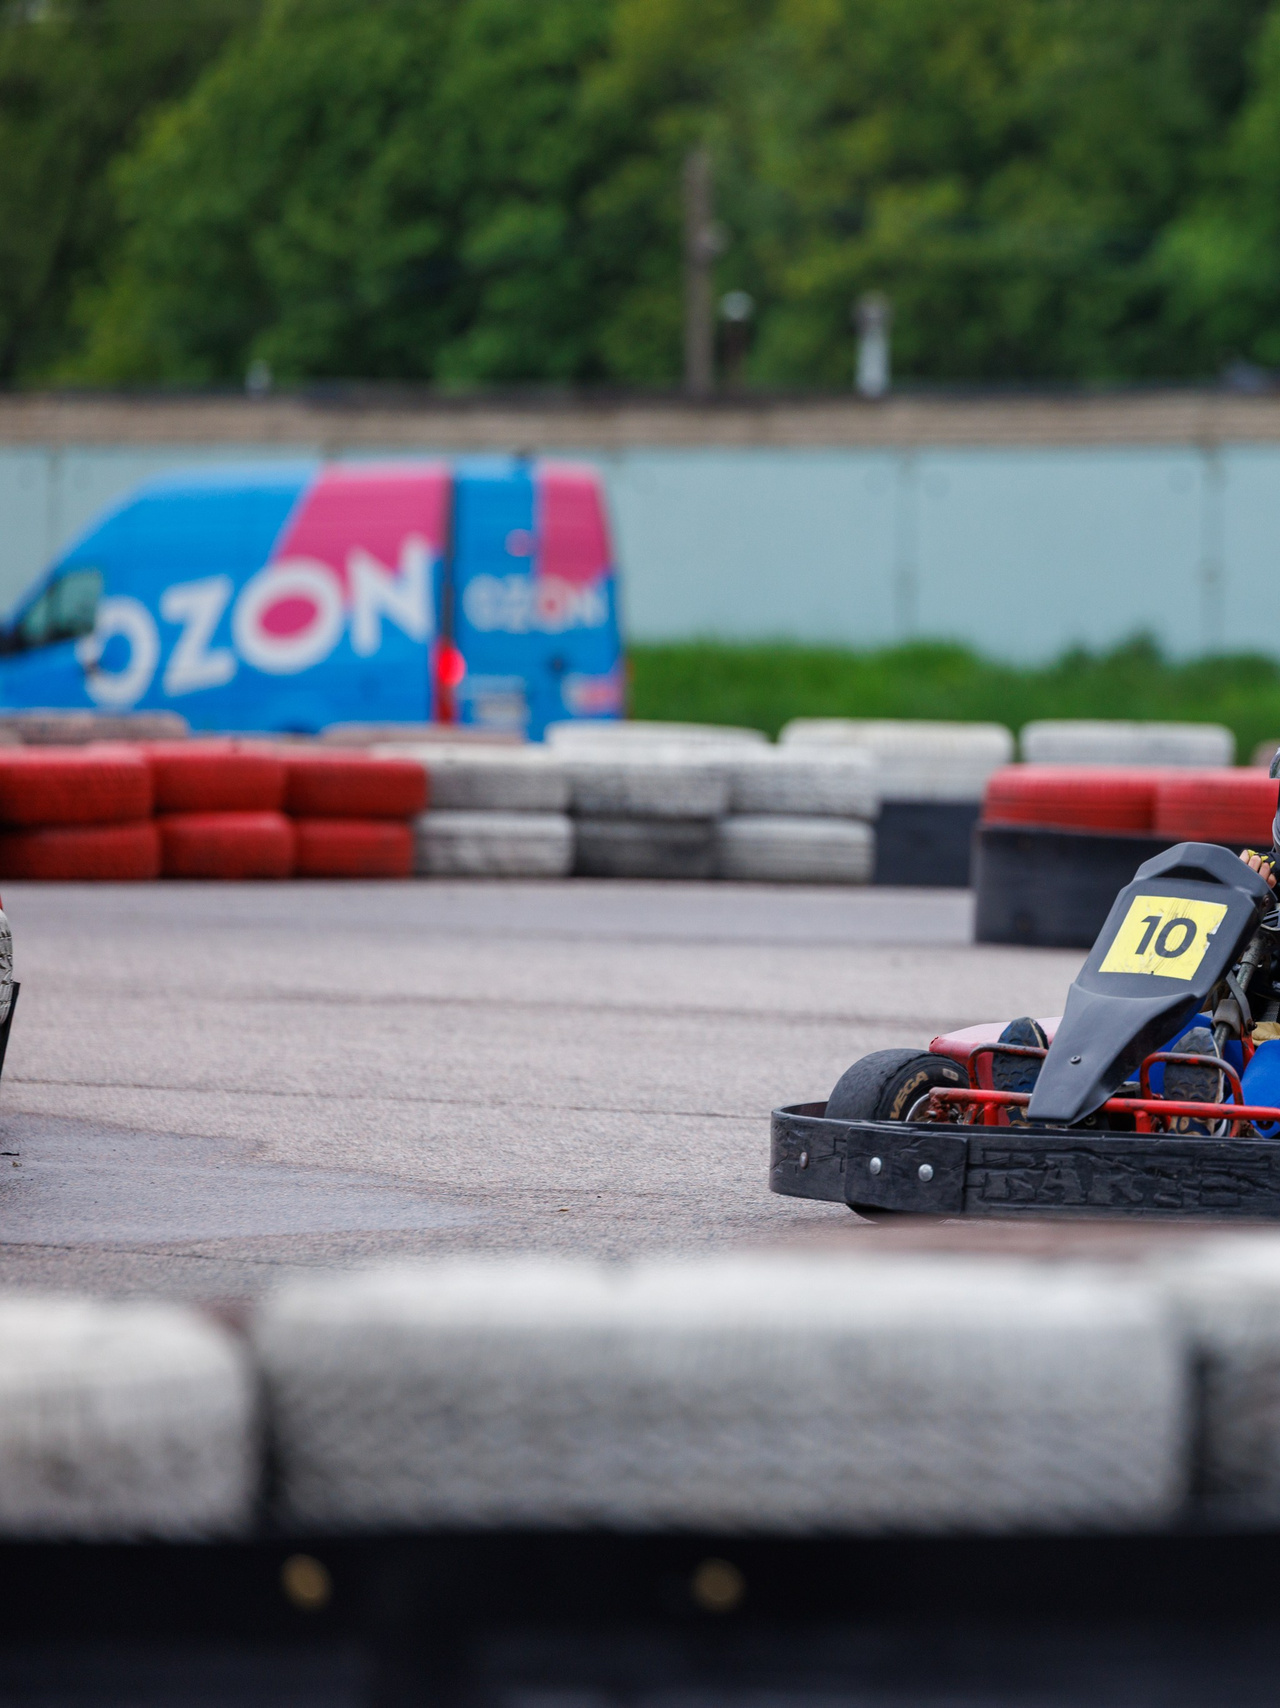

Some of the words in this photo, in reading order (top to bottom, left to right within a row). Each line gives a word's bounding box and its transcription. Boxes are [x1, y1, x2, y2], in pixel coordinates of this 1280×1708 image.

[75, 533, 436, 709] OZON
[463, 573, 609, 634] OZON
[1134, 915, 1198, 959] 10
[890, 1071, 929, 1119] VEGA
